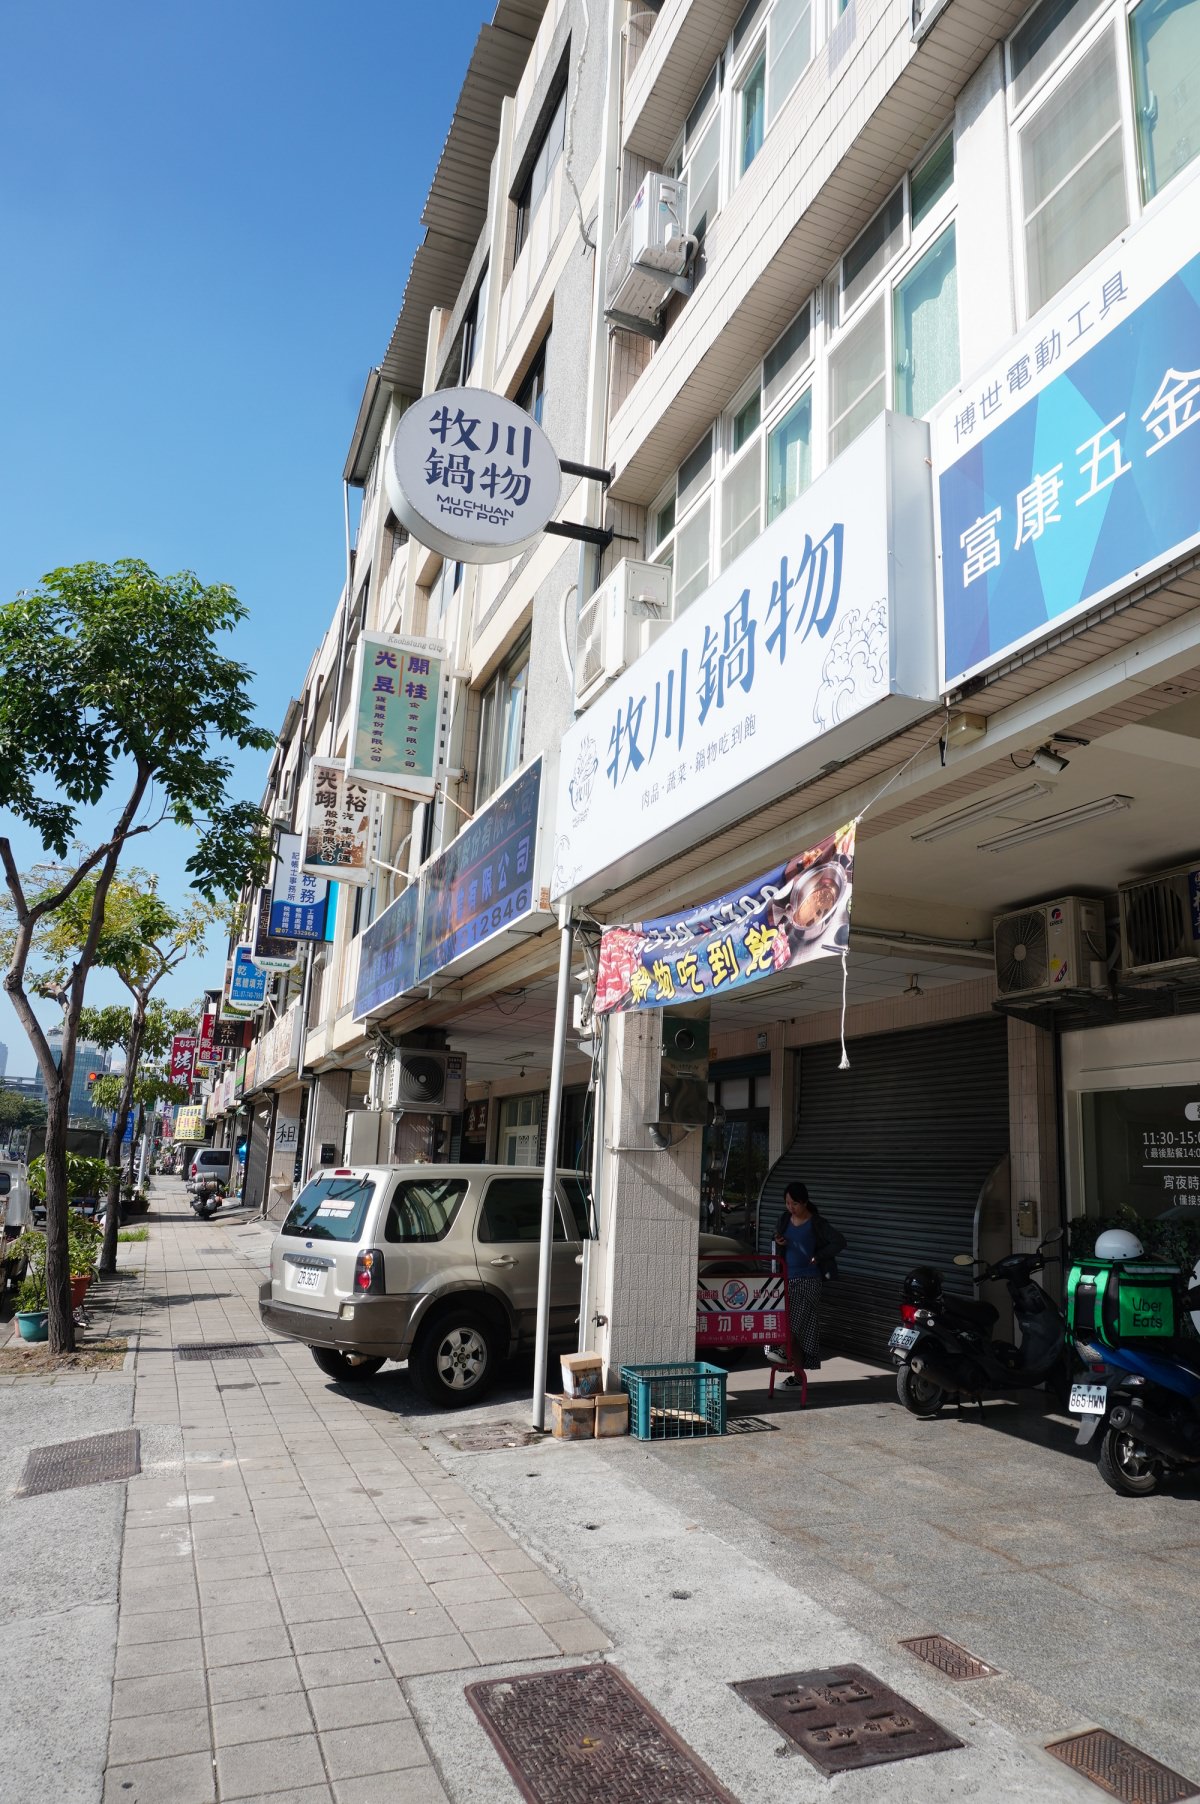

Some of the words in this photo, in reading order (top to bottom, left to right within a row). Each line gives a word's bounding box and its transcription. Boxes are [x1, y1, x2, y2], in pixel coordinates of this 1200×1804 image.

[953, 270, 1129, 445] 博世電動工具
[429, 405, 532, 469] 牧川
[424, 446, 532, 507] 鍋物
[959, 367, 1200, 588] 富康五金
[436, 494, 461, 507] MU
[463, 499, 514, 518] CHUAN
[440, 506, 474, 519] HOT
[476, 512, 510, 526] POT
[606, 522, 845, 790] 牧川鍋物
[276, 1123, 297, 1143] 租
[1132, 1296, 1163, 1312] Uber
[696, 1314, 777, 1333] 請勿停車
[1132, 1314, 1163, 1329] Eats
